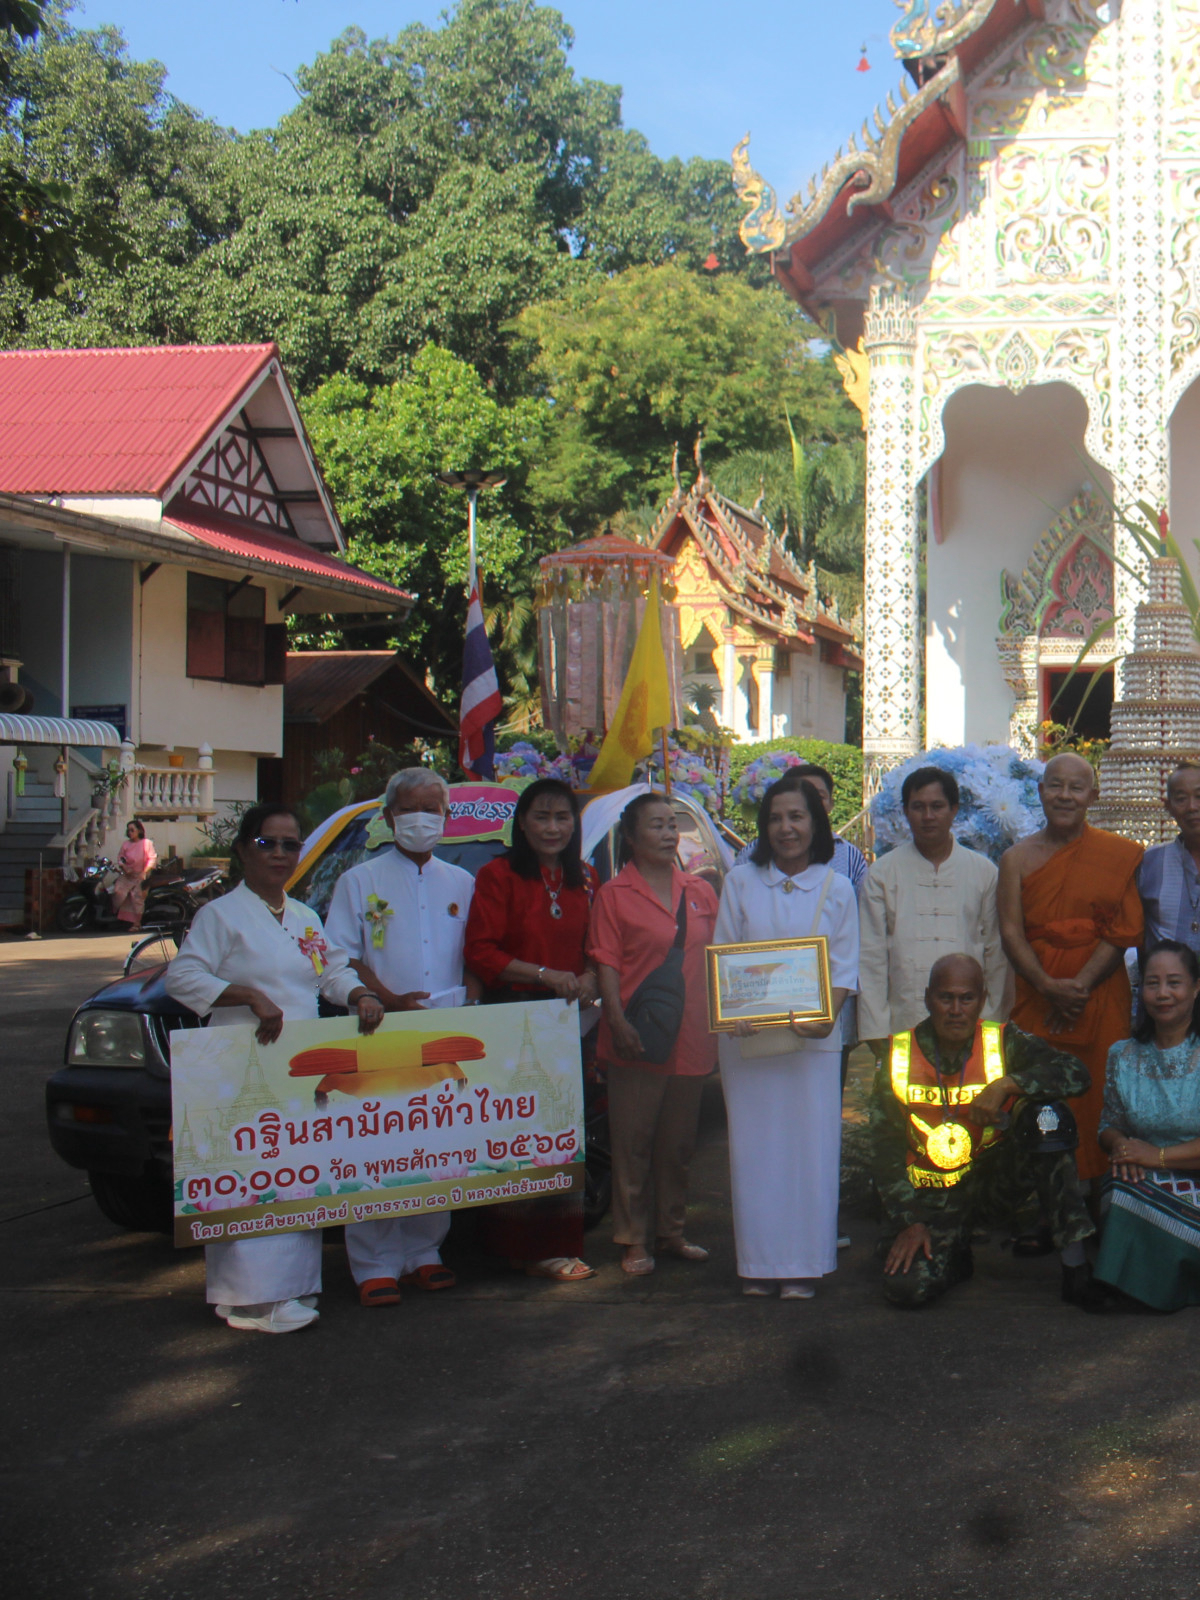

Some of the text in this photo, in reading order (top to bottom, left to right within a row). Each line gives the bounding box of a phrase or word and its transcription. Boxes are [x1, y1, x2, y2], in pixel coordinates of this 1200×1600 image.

[234, 1083, 535, 1159] กฐินสามัคคีทั่วไทย
[912, 1088, 984, 1102] POIC
[188, 1129, 576, 1199] ๓๐,๐๐๐ วัด พุทธศักราช ๒๕๖๘
[193, 1224, 222, 1238] โดย
[229, 1203, 347, 1233] คณะศิษยานุศิษย์
[353, 1198, 421, 1220] บูชาธรรม
[451, 1189, 462, 1202] ปี
[467, 1174, 571, 1200] หลวงพ่อธัมมชโย
